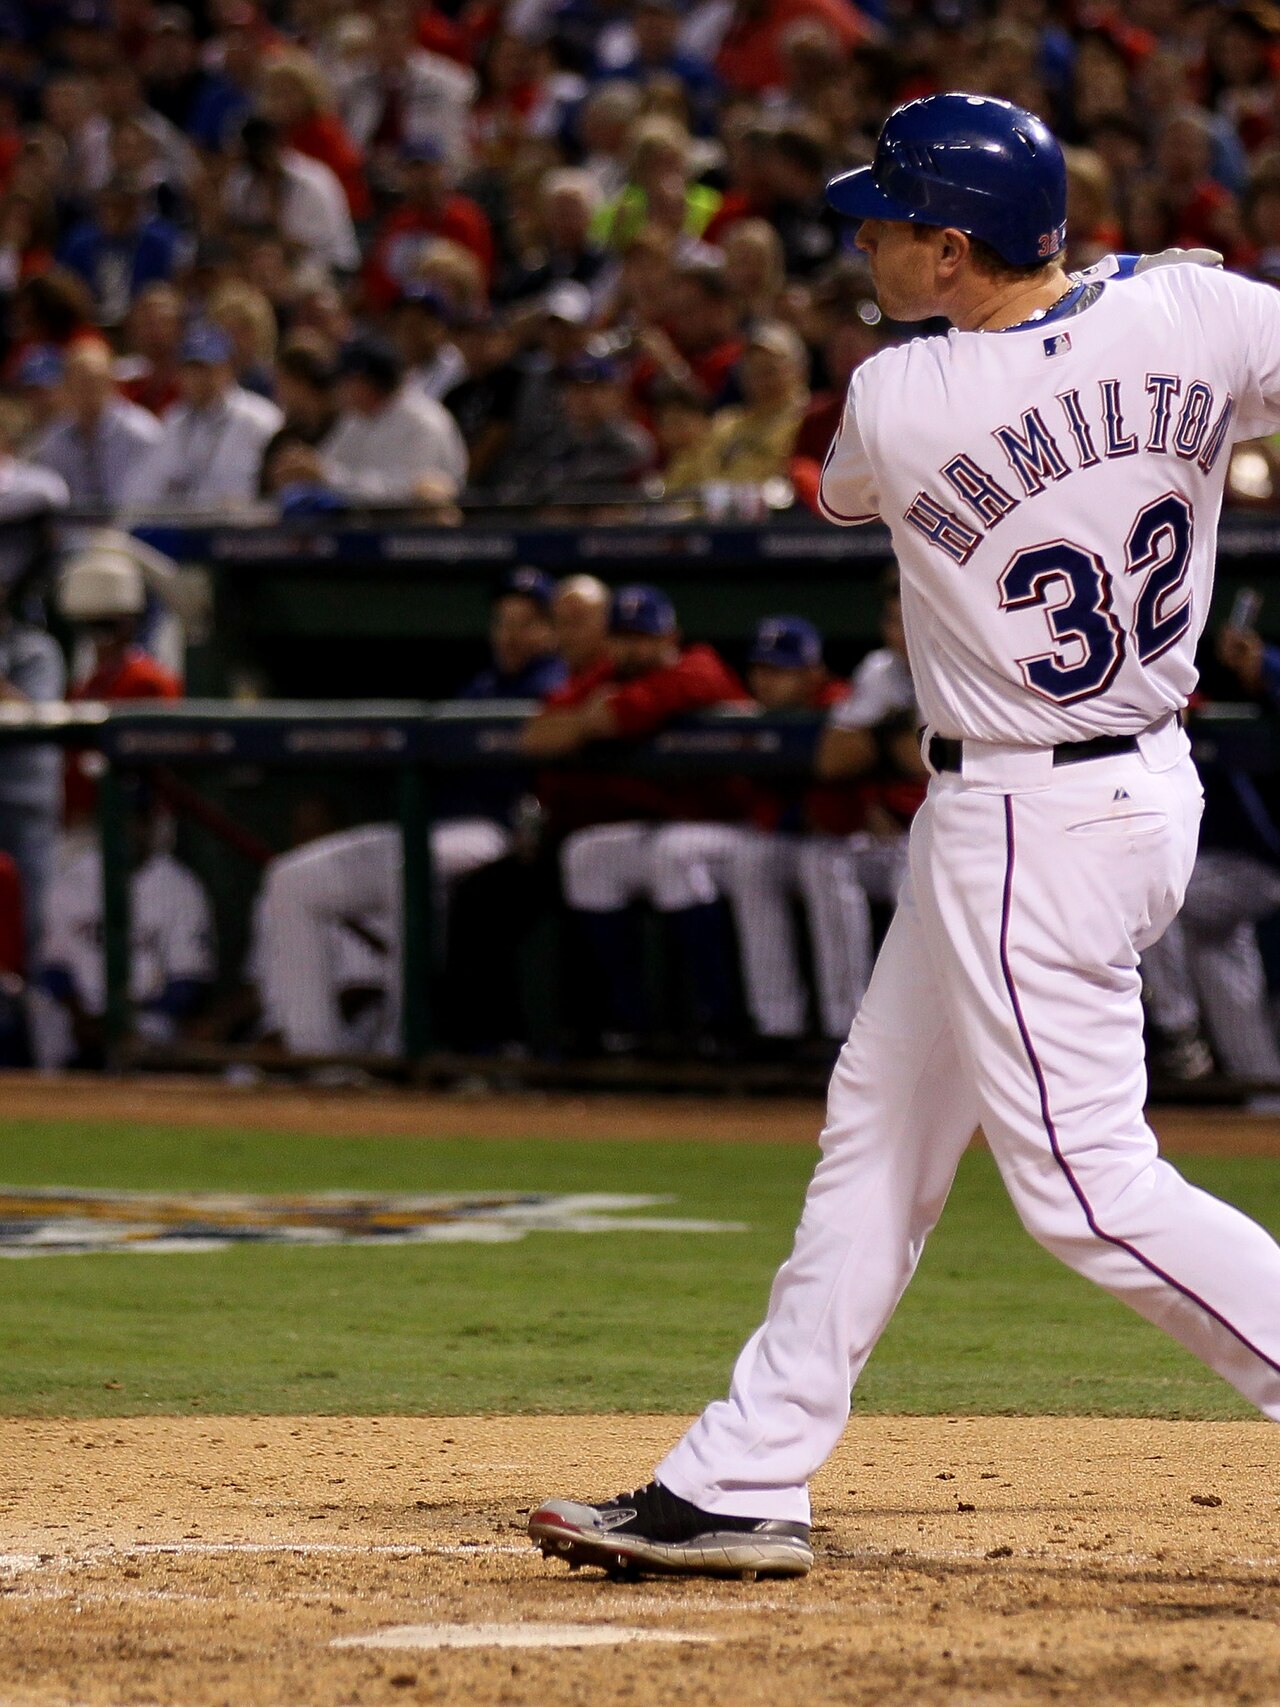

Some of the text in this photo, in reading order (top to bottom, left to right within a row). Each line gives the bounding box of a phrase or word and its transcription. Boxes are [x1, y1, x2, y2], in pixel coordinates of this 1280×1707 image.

[1038, 230, 1060, 257] 32
[903, 372, 1234, 567] HAMILTON
[998, 490, 1194, 708] 32
